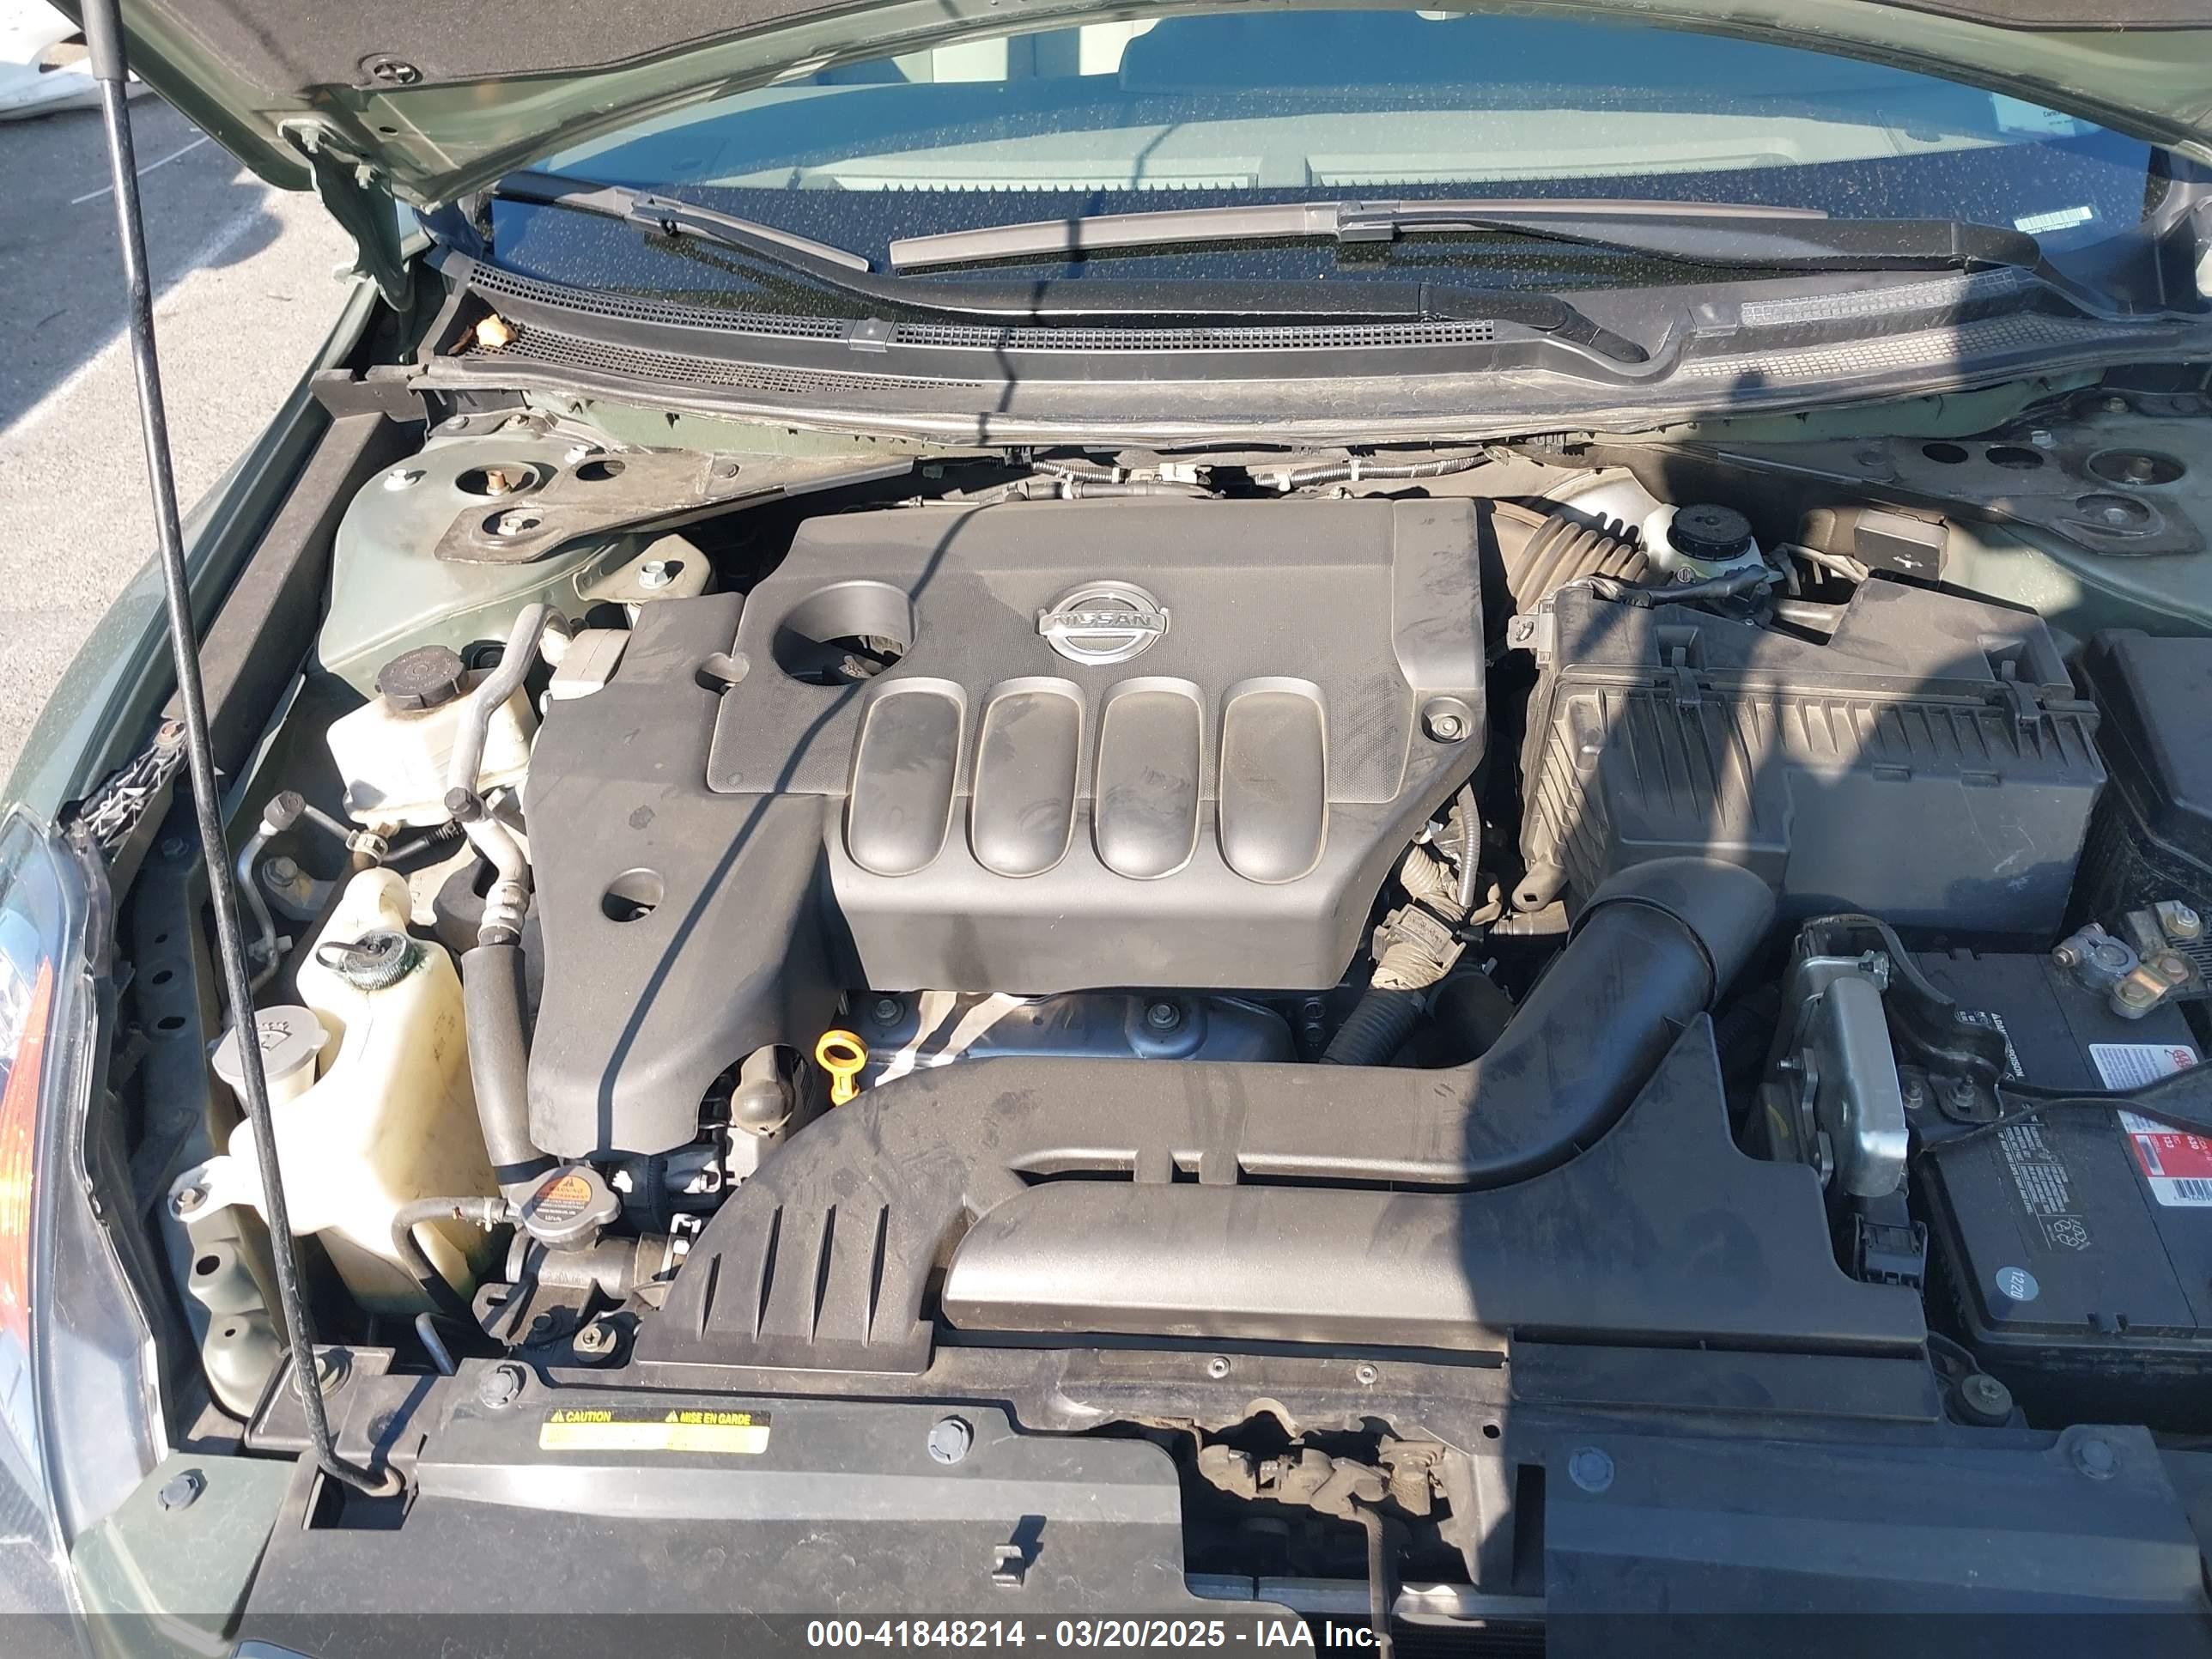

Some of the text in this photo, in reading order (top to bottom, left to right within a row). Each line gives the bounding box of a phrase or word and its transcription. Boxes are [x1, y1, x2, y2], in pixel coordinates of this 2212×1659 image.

[1054, 611, 1152, 627] NISSAN
[2011, 1271, 2025, 1299] 12/20
[566, 1411, 611, 1423] CAUTION
[680, 1413, 751, 1425] MISE EN GARDE
